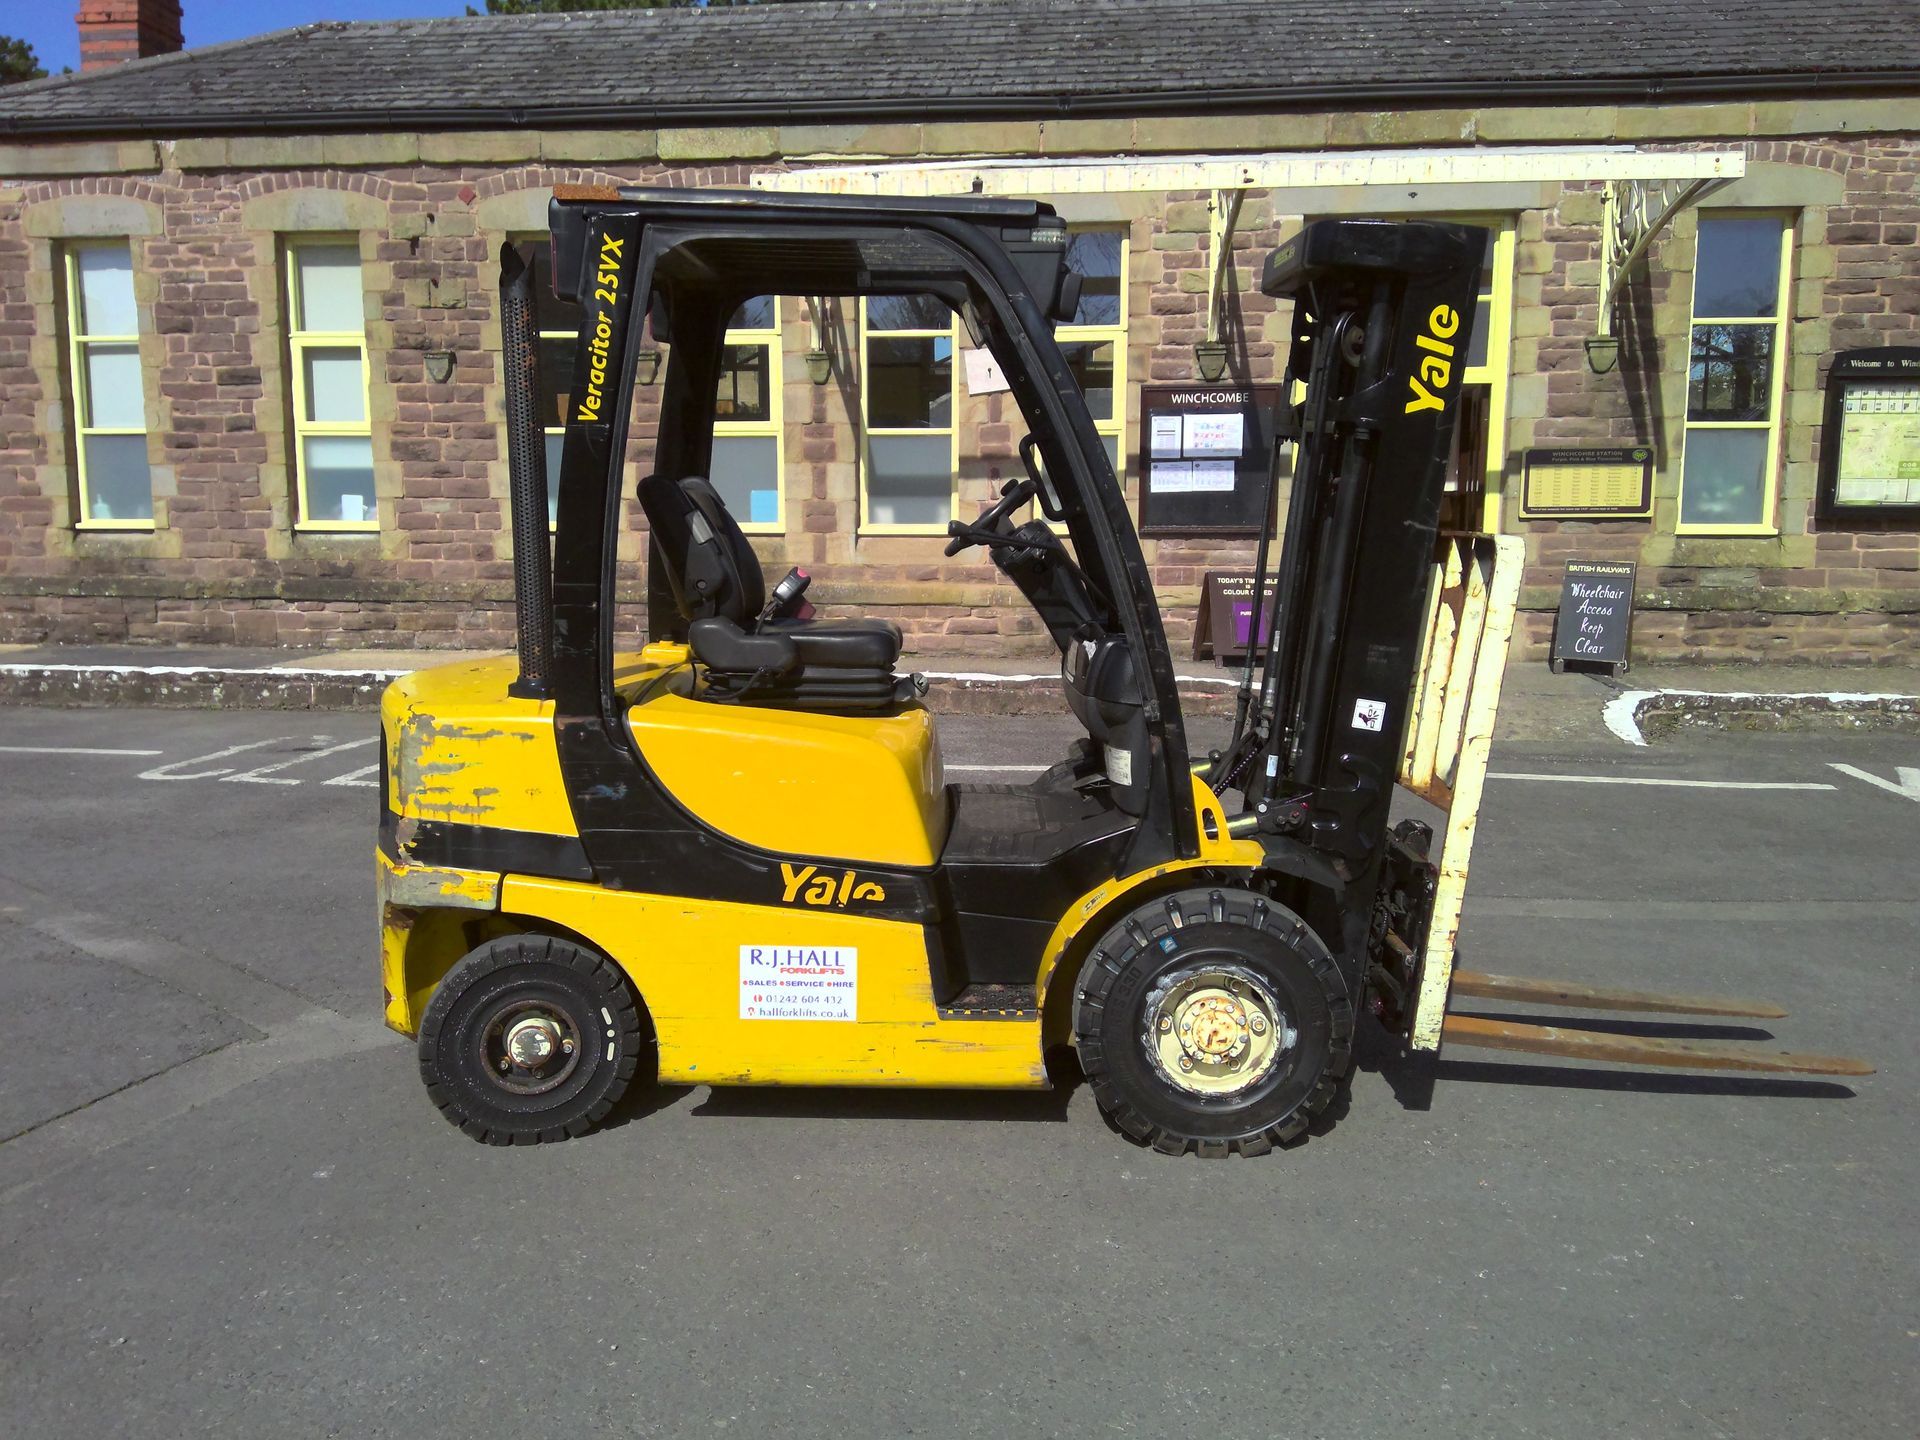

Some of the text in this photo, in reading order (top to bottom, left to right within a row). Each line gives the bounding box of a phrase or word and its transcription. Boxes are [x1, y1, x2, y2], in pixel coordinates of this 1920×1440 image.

[577, 232, 624, 421] Veracitor 25VX
[1404, 304, 1460, 415] Yale
[1850, 359, 1882, 367] Welcome
[1171, 392, 1249, 404] WINCHCOMBE
[1568, 564, 1631, 574] BRITISH RAILWAYS
[1571, 583, 1625, 599] Wheelchair
[1576, 598, 1613, 615] Access
[1574, 637, 1604, 654] Clear
[780, 863, 886, 907] Yale
[780, 967, 845, 975] FORKLIFTS
[766, 995, 842, 1004] 01242 604 432
[759, 1007, 849, 1018] hallforklifts.co.uk
